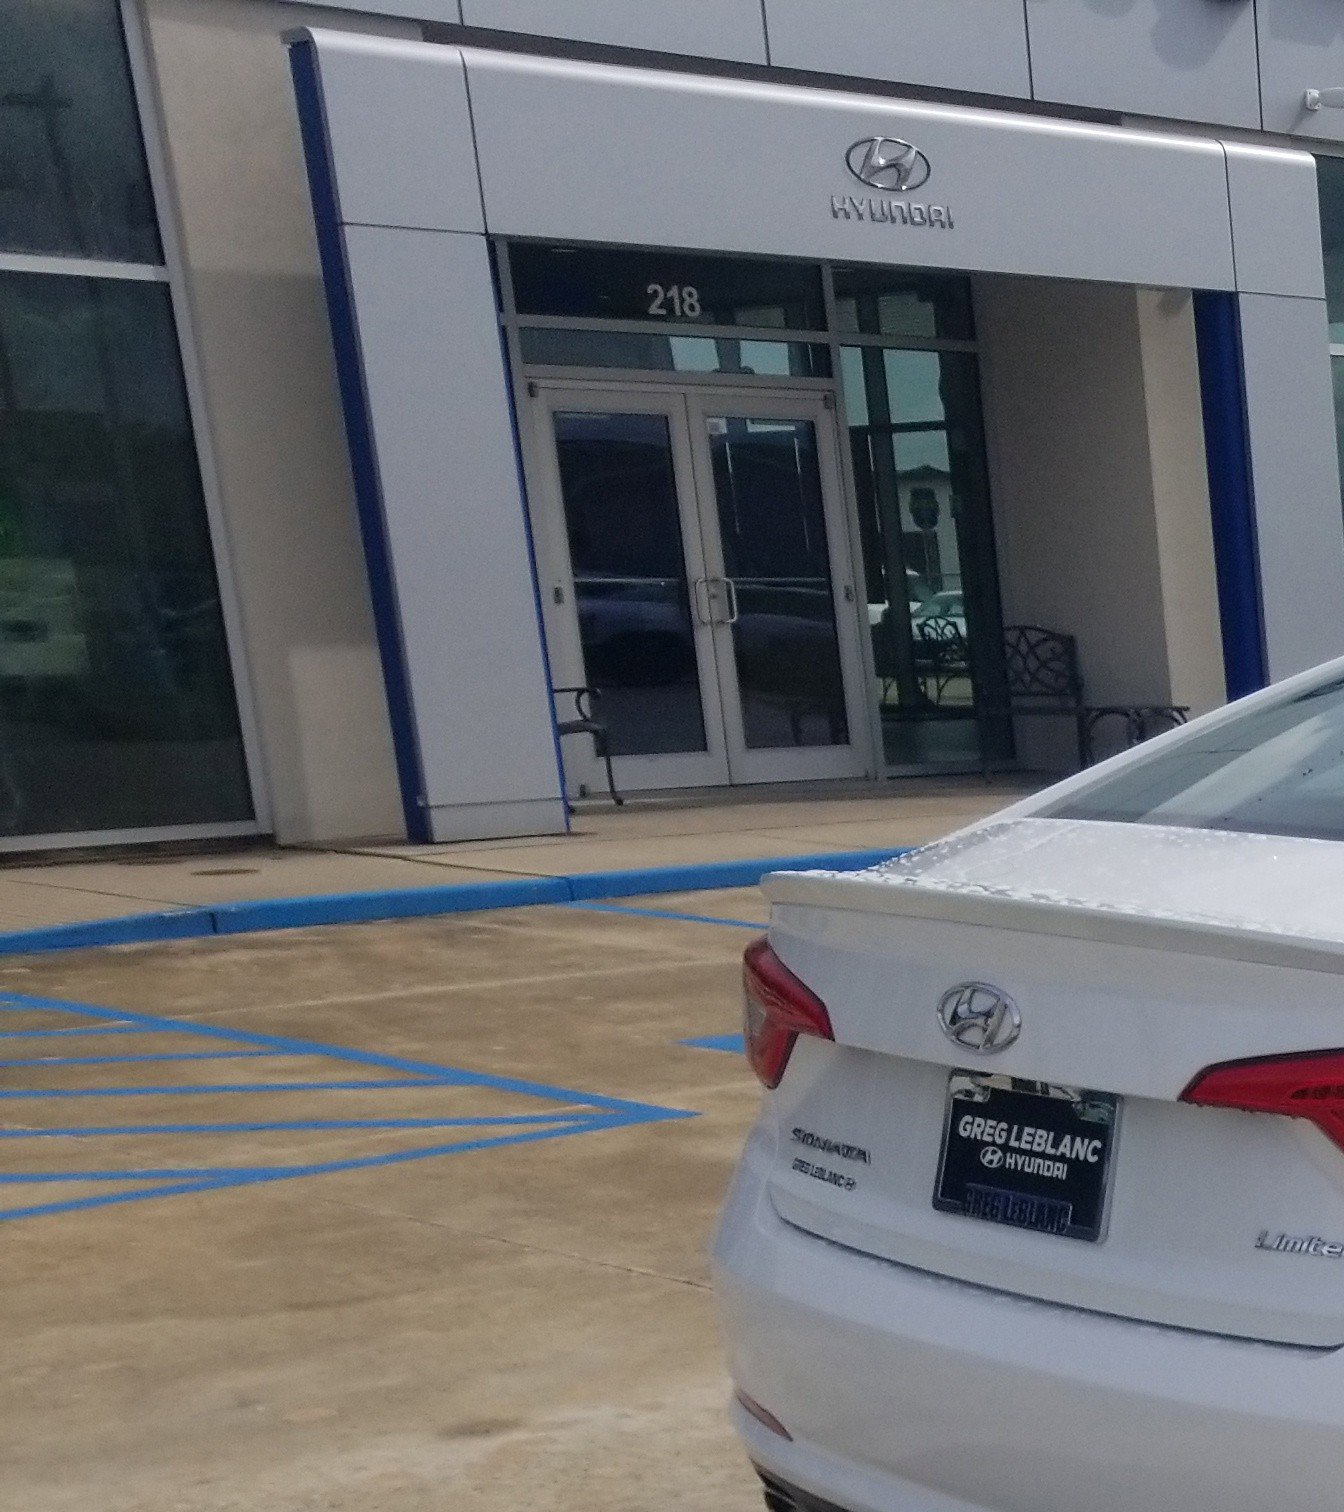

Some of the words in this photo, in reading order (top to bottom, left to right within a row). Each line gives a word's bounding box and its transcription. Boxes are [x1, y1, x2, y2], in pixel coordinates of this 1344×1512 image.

[831, 195, 955, 229] HYUNDAI
[647, 284, 701, 317] 218
[958, 1115, 1009, 1144] GREG
[1009, 1124, 1103, 1163] LEBLANC
[1006, 1152, 1068, 1180] HYUNDAI
